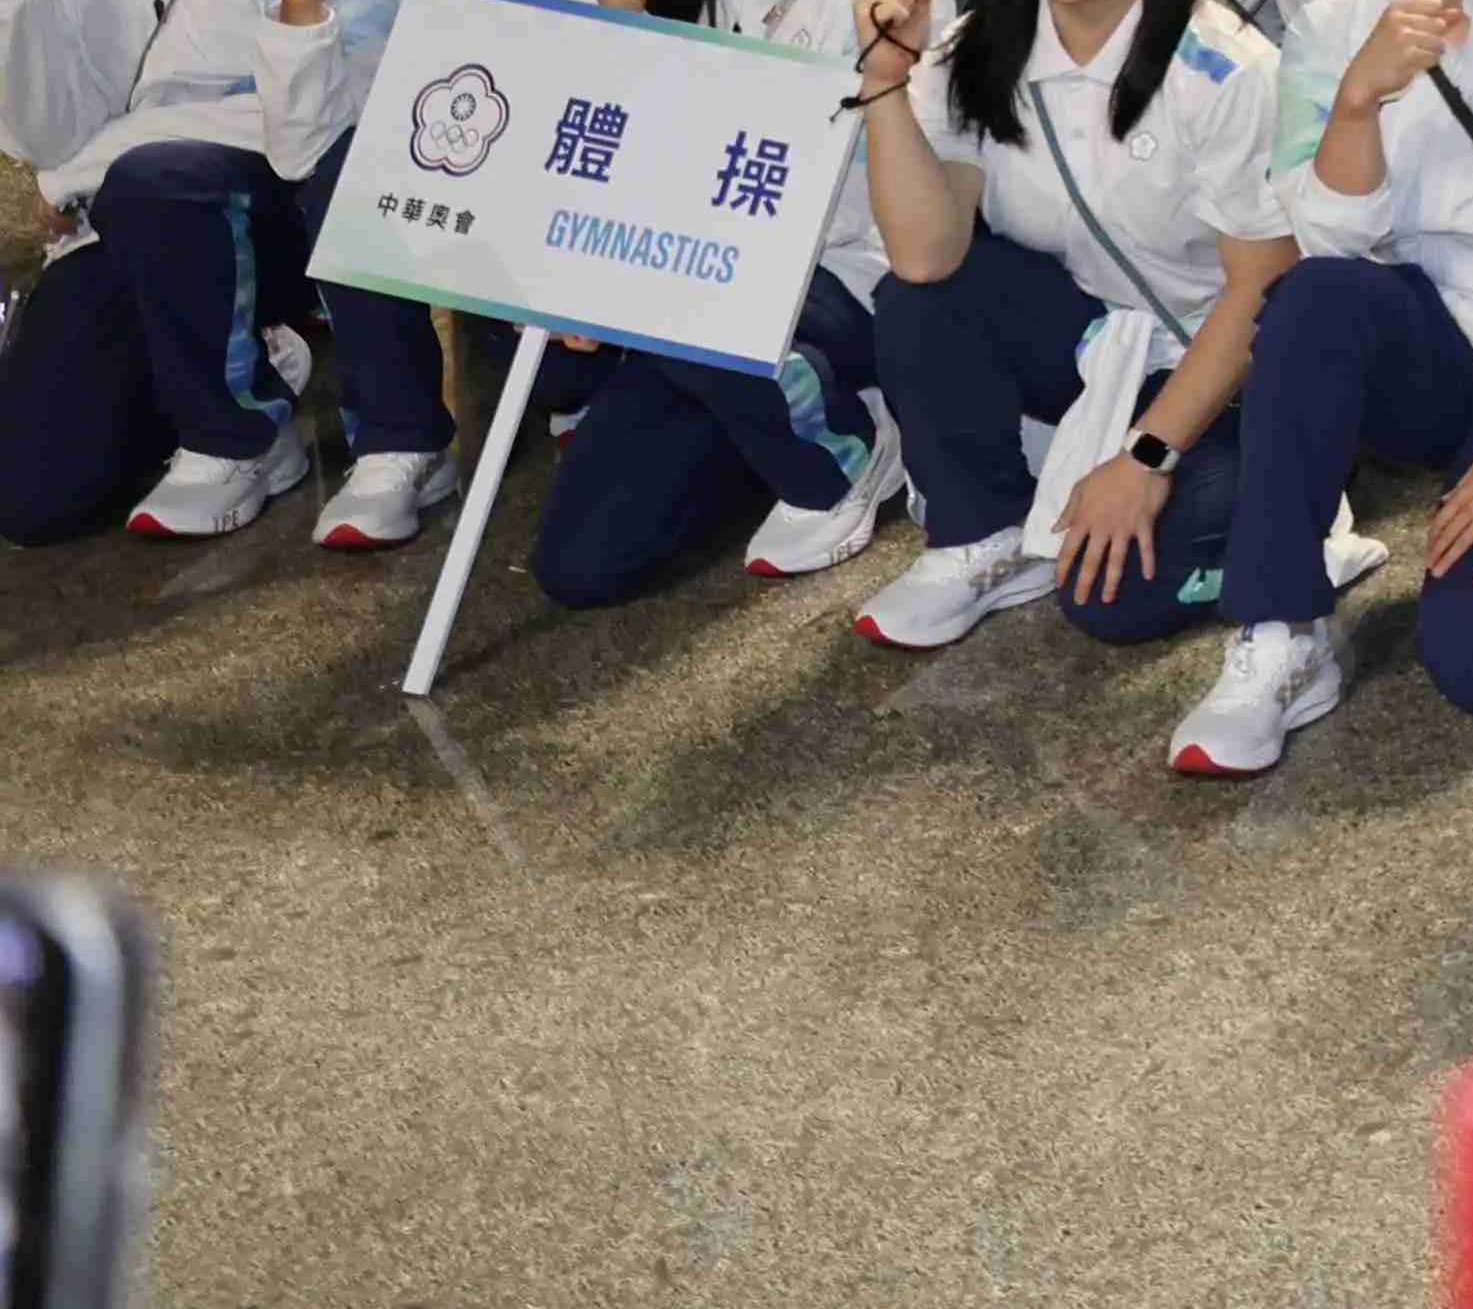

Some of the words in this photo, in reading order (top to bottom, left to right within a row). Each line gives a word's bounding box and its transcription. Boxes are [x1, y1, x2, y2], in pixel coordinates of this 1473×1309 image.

[545, 96, 791, 219] 體操
[375, 191, 477, 238] 中華奧會
[545, 208, 740, 284] GYMNASTICS
